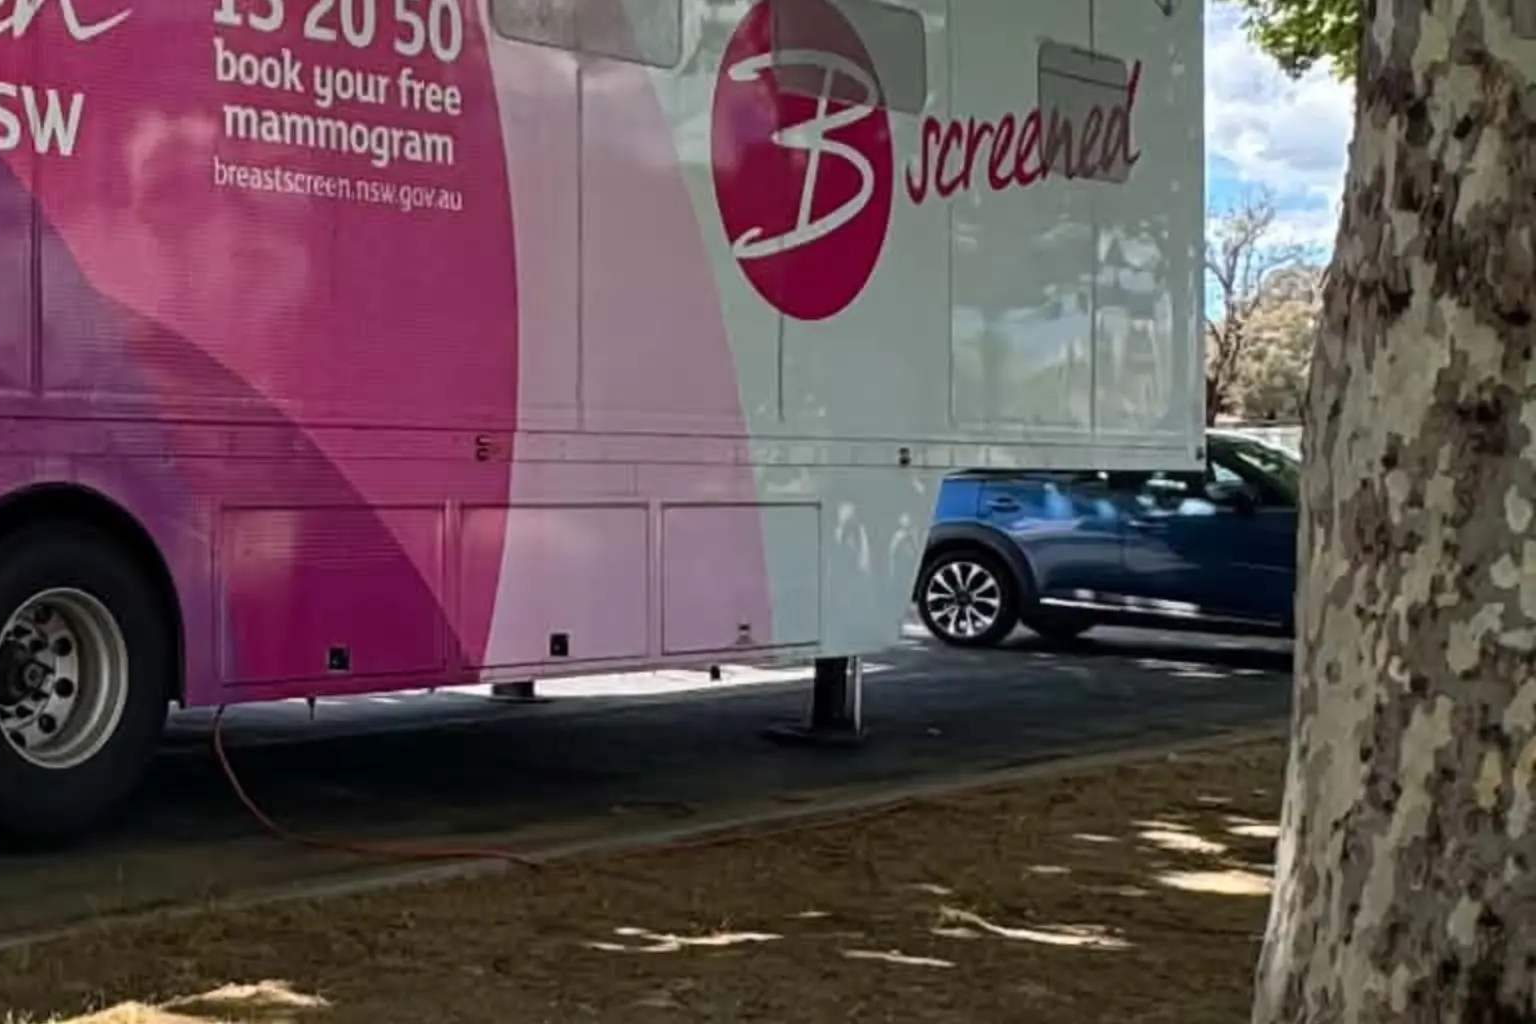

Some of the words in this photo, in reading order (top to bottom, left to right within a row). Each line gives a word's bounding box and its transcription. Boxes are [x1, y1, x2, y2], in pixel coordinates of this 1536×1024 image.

[213, 37, 303, 92] book
[314, 66, 390, 107] your
[399, 68, 461, 114] free
[223, 104, 453, 167] mammogram
[905, 60, 1141, 203] screened
[213, 157, 463, 211] breastscreen.nsw.gov.au
